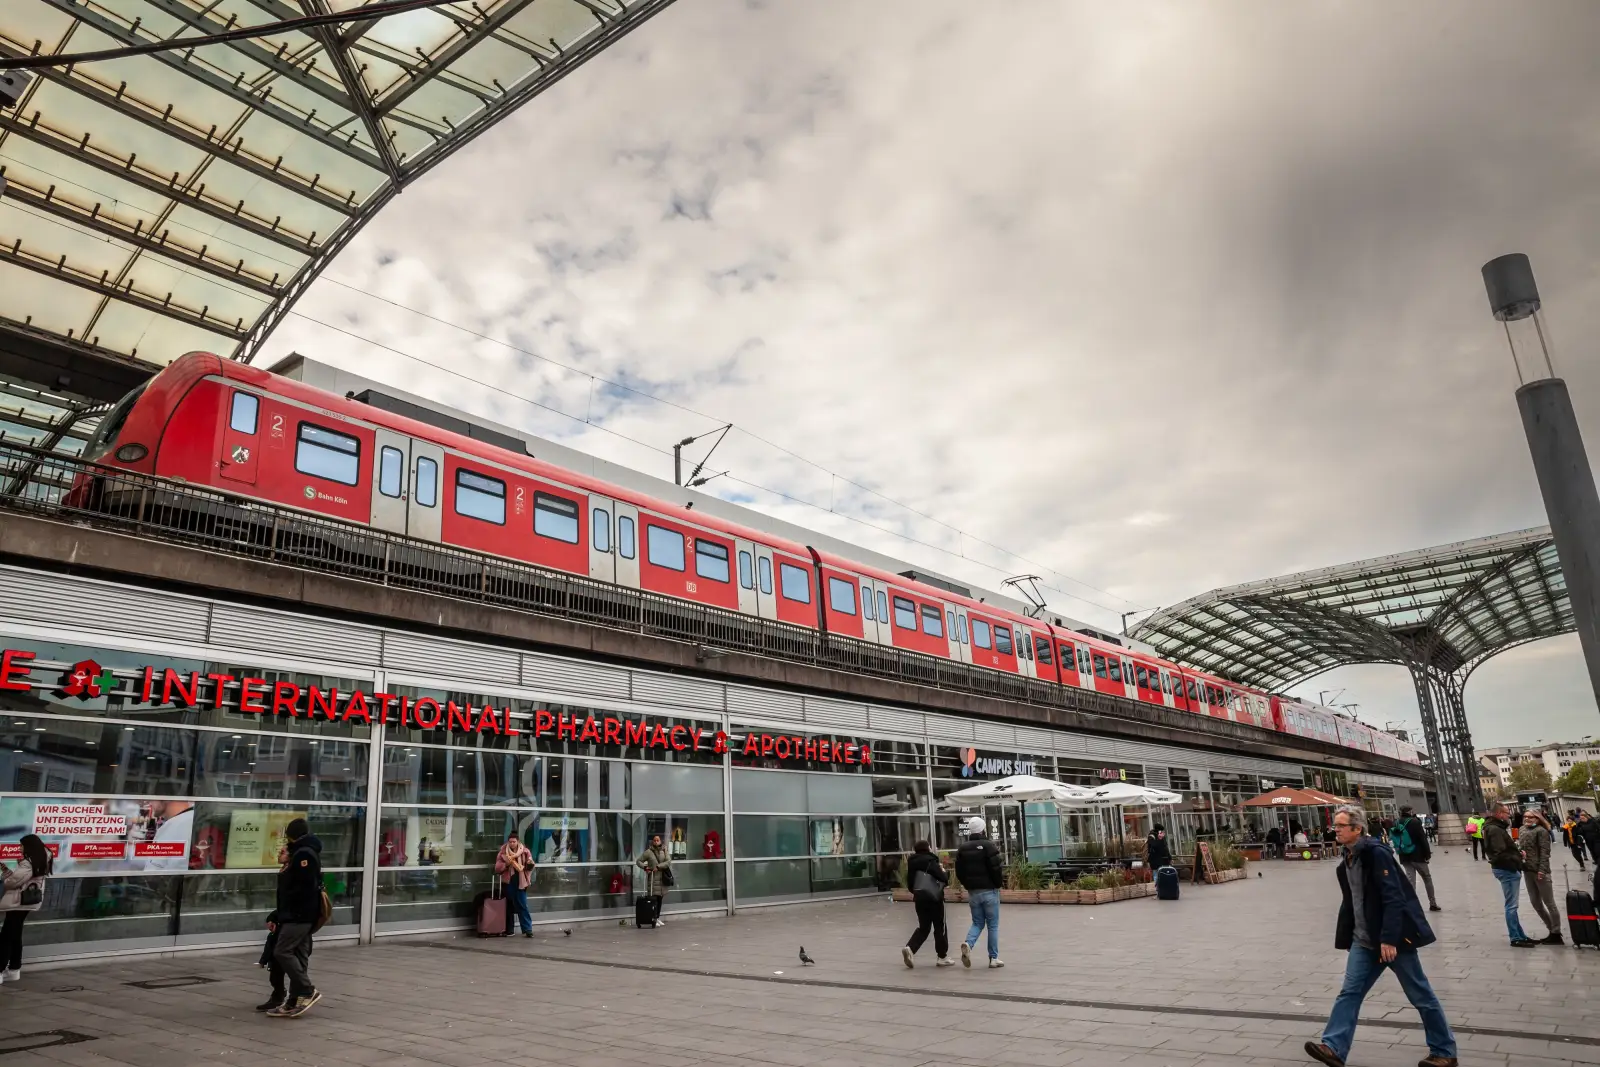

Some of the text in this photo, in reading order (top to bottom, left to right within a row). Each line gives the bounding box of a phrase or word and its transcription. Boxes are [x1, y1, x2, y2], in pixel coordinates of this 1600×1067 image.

[272, 415, 283, 432] 2
[318, 492, 334, 501] Bahn
[334, 494, 348, 504] Köln
[516, 488, 524, 500] 2
[686, 536, 692, 548] 2
[686, 581, 697, 592] DB
[140, 665, 520, 736] INTERNATIONAL
[535, 710, 703, 752] PHARMACY
[743, 732, 855, 764] APOTHEKE
[976, 758, 1036, 776] CAMPUS SUITE
[38, 806, 59, 814] WIR
[36, 815, 124, 824] UNTERSTÜTZUNG
[35, 825, 56, 834] FÜR
